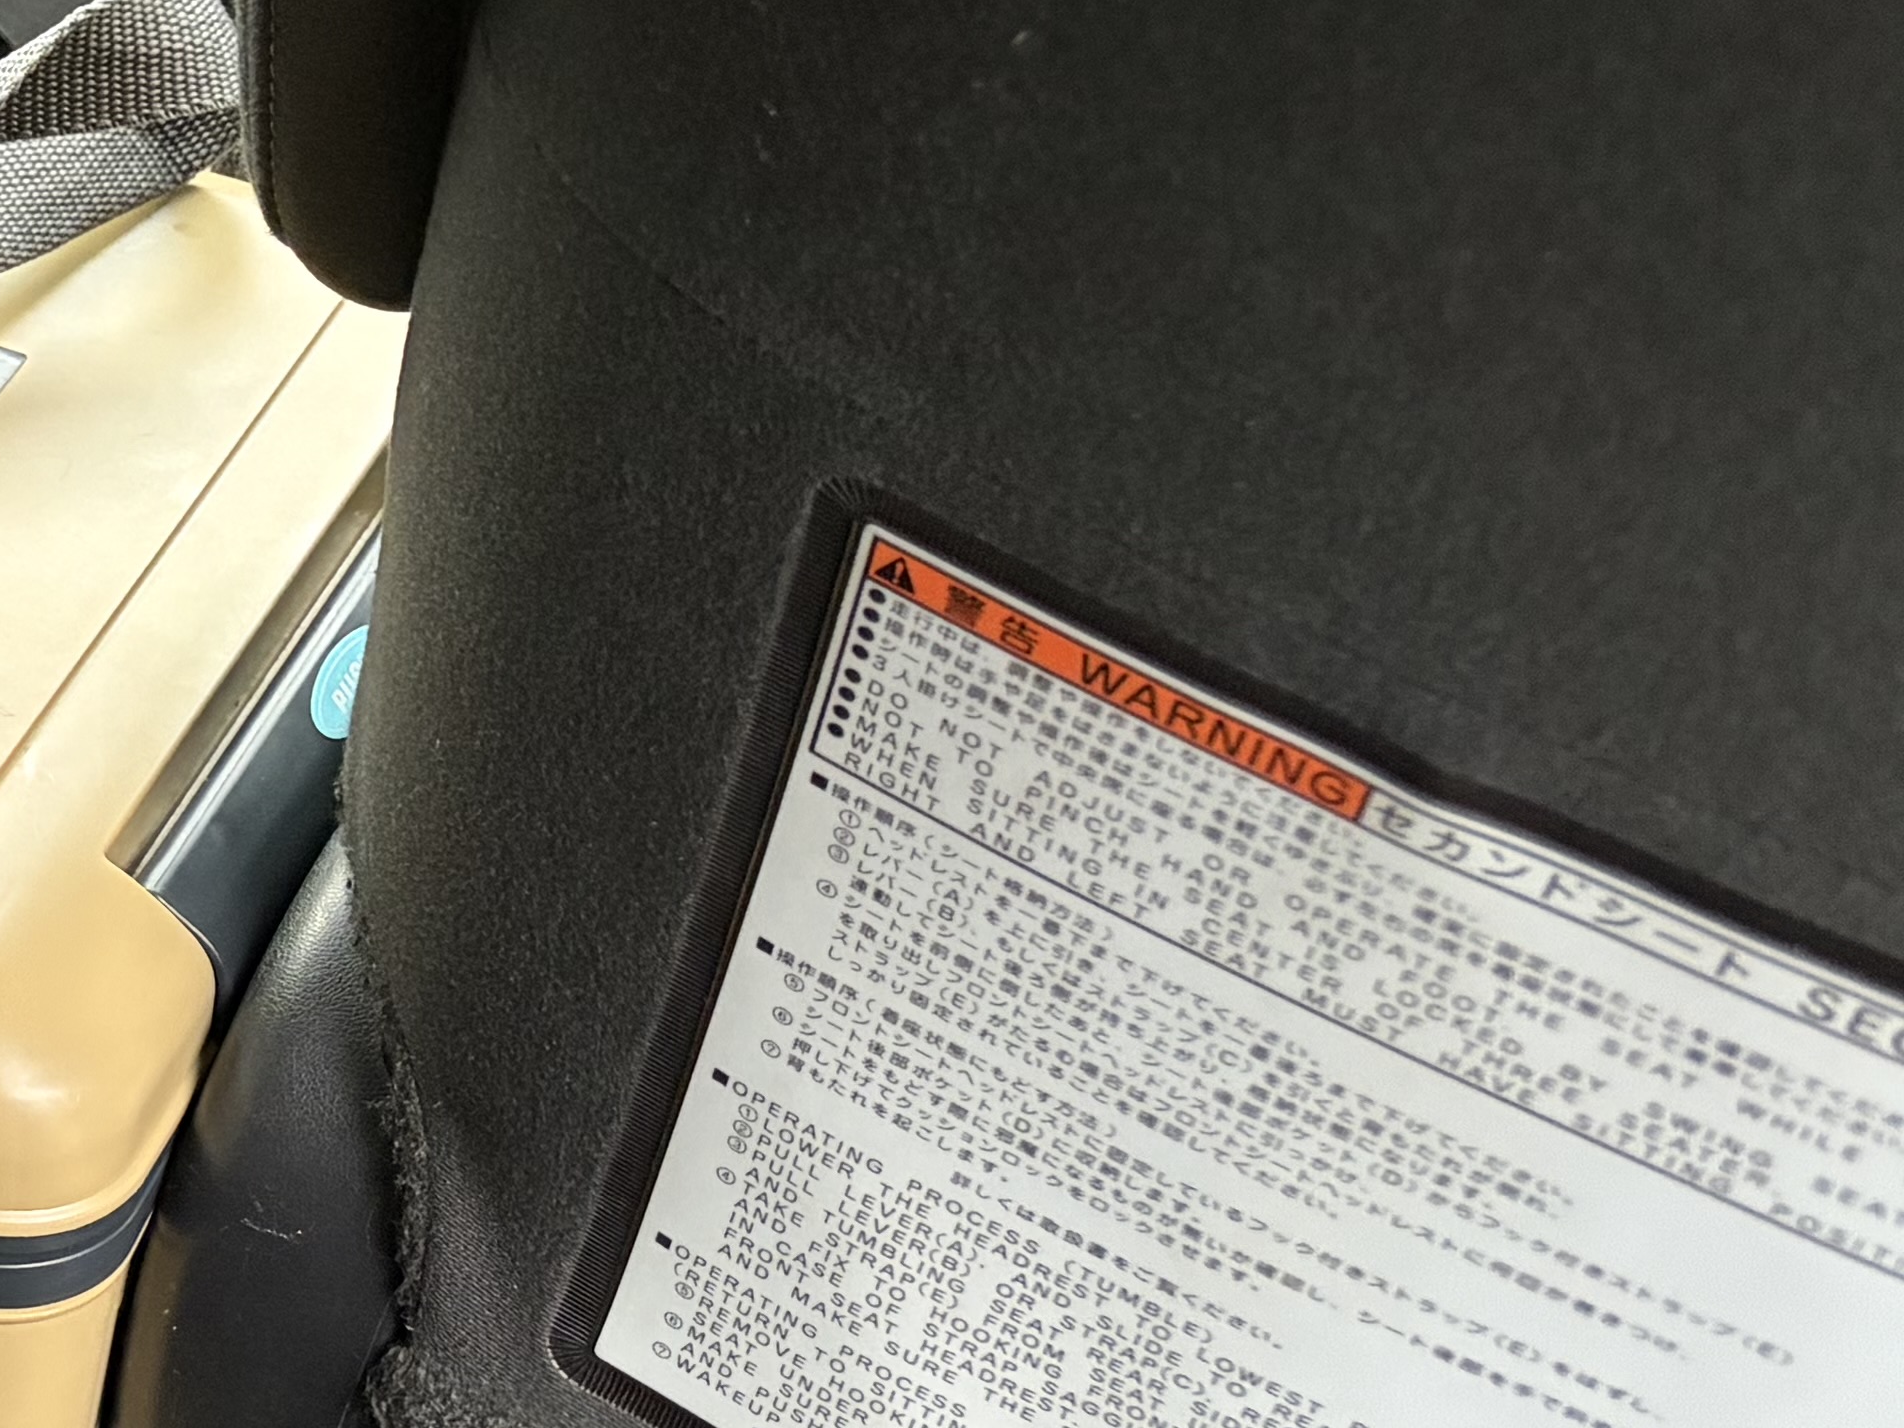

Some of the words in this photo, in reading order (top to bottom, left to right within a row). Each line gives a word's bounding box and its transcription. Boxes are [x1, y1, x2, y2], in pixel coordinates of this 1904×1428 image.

[855, 714, 942, 773] MAKE
[969, 777, 1057, 833] SURE
[1089, 837, 1152, 881] THE
[860, 696, 925, 739] NOT
[956, 746, 995, 778] TO
[1024, 784, 1130, 848] PINCH
[866, 678, 910, 711] DO
[938, 717, 1004, 760] NOT
[1032, 769, 1171, 844] ADJUST
[1080, 652, 1351, 807] WARNING
[843, 751, 941, 812] RIGHT
[968, 822, 1037, 863] AND
[1065, 869, 1151, 920] LEFT
[850, 731, 938, 792] WHEN
[965, 797, 1103, 877] SITTING
[1133, 883, 1171, 911] IN
[1374, 790, 1751, 995] セカンドシート
[723, 1226, 810, 1284] FRONT
[830, 1291, 899, 1335] SEAT
[728, 1210, 755, 1235] IN
[775, 1240, 844, 1289] CASE
[864, 1292, 902, 1316] OF
[922, 1322, 1019, 1373] STRAP
[731, 1080, 884, 1175] OPERATING
[906, 1178, 1041, 1255] PROCESS
[1063, 1259, 1213, 1344] (TUMBLE)
[733, 1197, 787, 1235] AND
[807, 1240, 850, 1274] FIX
[873, 1274, 907, 1303] TO
[928, 1305, 1063, 1380] HOOKING
[744, 1166, 799, 1204] AND
[823, 1208, 966, 1294] TUMBLING
[989, 1298, 1065, 1341] SEAT
[1085, 1346, 1168, 1396] REAR
[751, 1149, 814, 1197] PULL
[837, 1199, 971, 1278] LEVER(B)
[995, 1282, 1037, 1312] OR
[756, 1133, 820, 1182] PULL
[1010, 1272, 1072, 1309] AND
[1095, 1314, 1184, 1368] SLIDE
[1208, 1369, 1248, 1398] TO
[762, 1117, 855, 1180] LOWER
[879, 1181, 932, 1220] THE
[952, 1221, 1111, 1308] HEADREST
[1135, 1313, 1173, 1342] TO
[1195, 1346, 1325, 1415] LOWEST
[673, 1261, 790, 1341] (RETURN
[814, 1346, 846, 1374] TO
[674, 1244, 818, 1340] OPERATING
[838, 1344, 967, 1418] PROCESS
[679, 1341, 733, 1379] AND
[686, 1325, 758, 1378] MAKE
[692, 1311, 758, 1356] SEAT
[779, 1363, 869, 1426] UNDER
[697, 1295, 807, 1370] REMOVE
[716, 1243, 770, 1281] AND
[790, 1285, 864, 1337] MAKE
[883, 1340, 959, 1386] SURE
[983, 1386, 1037, 1423] THE
[743, 1179, 805, 1229] TAKE
[824, 1231, 959, 1310] STRAP(E)
[982, 1313, 1066, 1363] FROM
[1088, 1367, 1166, 1412] SEAT
[676, 1354, 781, 1423] WAKEUP
